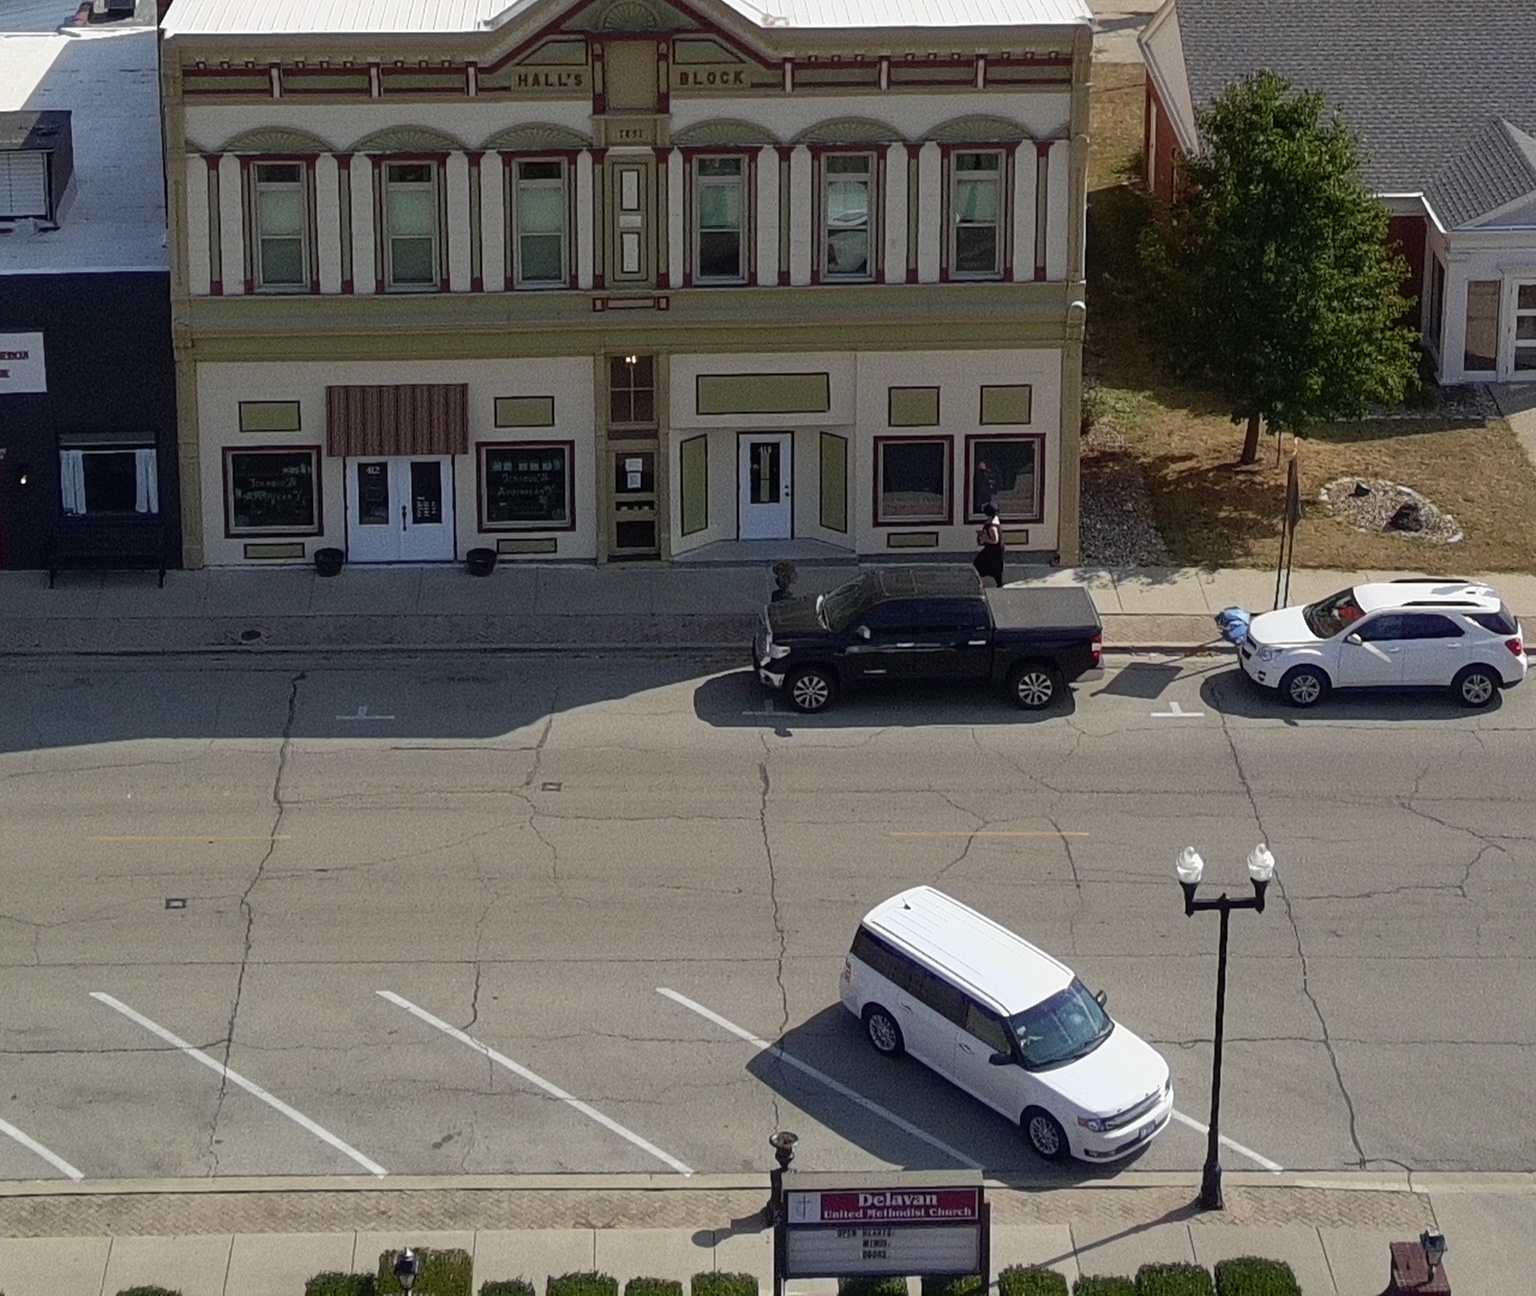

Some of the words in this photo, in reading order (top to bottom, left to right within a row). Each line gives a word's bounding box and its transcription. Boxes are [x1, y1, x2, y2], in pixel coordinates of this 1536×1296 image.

[517, 72, 583, 87] HALL'S
[679, 70, 744, 86] BLOCK
[858, 1192, 938, 1207] Delavan
[824, 1208, 864, 1219] United
[867, 1207, 925, 1219] Methodist
[929, 1206, 972, 1217] Church
